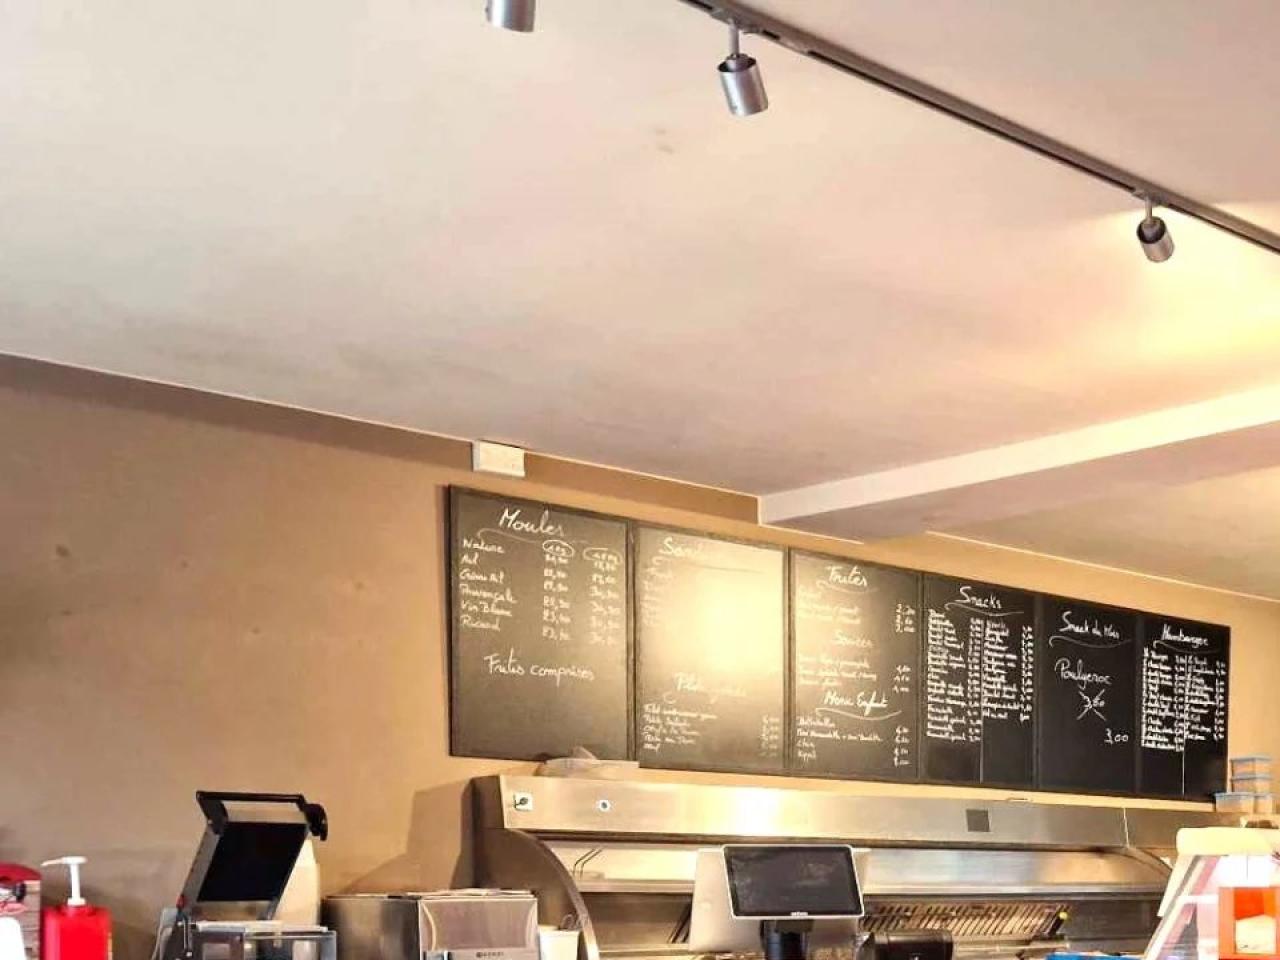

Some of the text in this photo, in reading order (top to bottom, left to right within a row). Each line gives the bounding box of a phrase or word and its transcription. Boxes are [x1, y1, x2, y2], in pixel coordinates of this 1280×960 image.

[500, 507, 565, 537] Moules
[826, 565, 868, 587] Frites
[483, 647, 596, 687] Frites comprises
[823, 690, 890, 716] Menu Enfant
